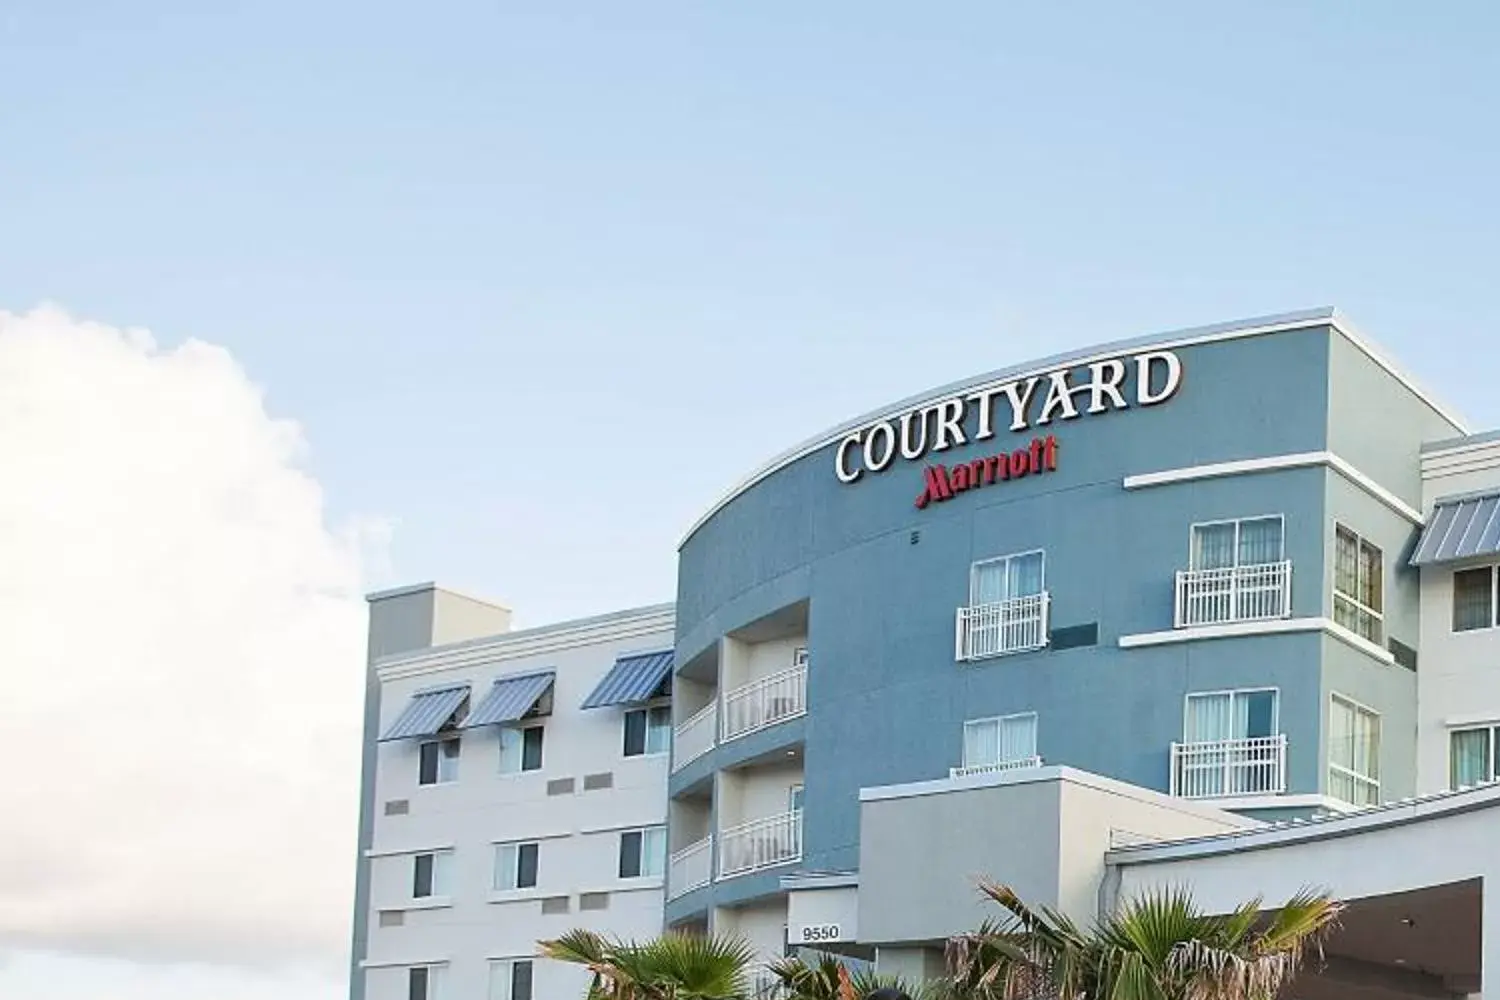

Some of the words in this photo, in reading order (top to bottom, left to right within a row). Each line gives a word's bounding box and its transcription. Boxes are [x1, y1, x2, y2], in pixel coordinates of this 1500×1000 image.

[835, 350, 1183, 483] COURTYARD
[914, 434, 1059, 509] Marriott
[803, 925, 839, 941] 9550
